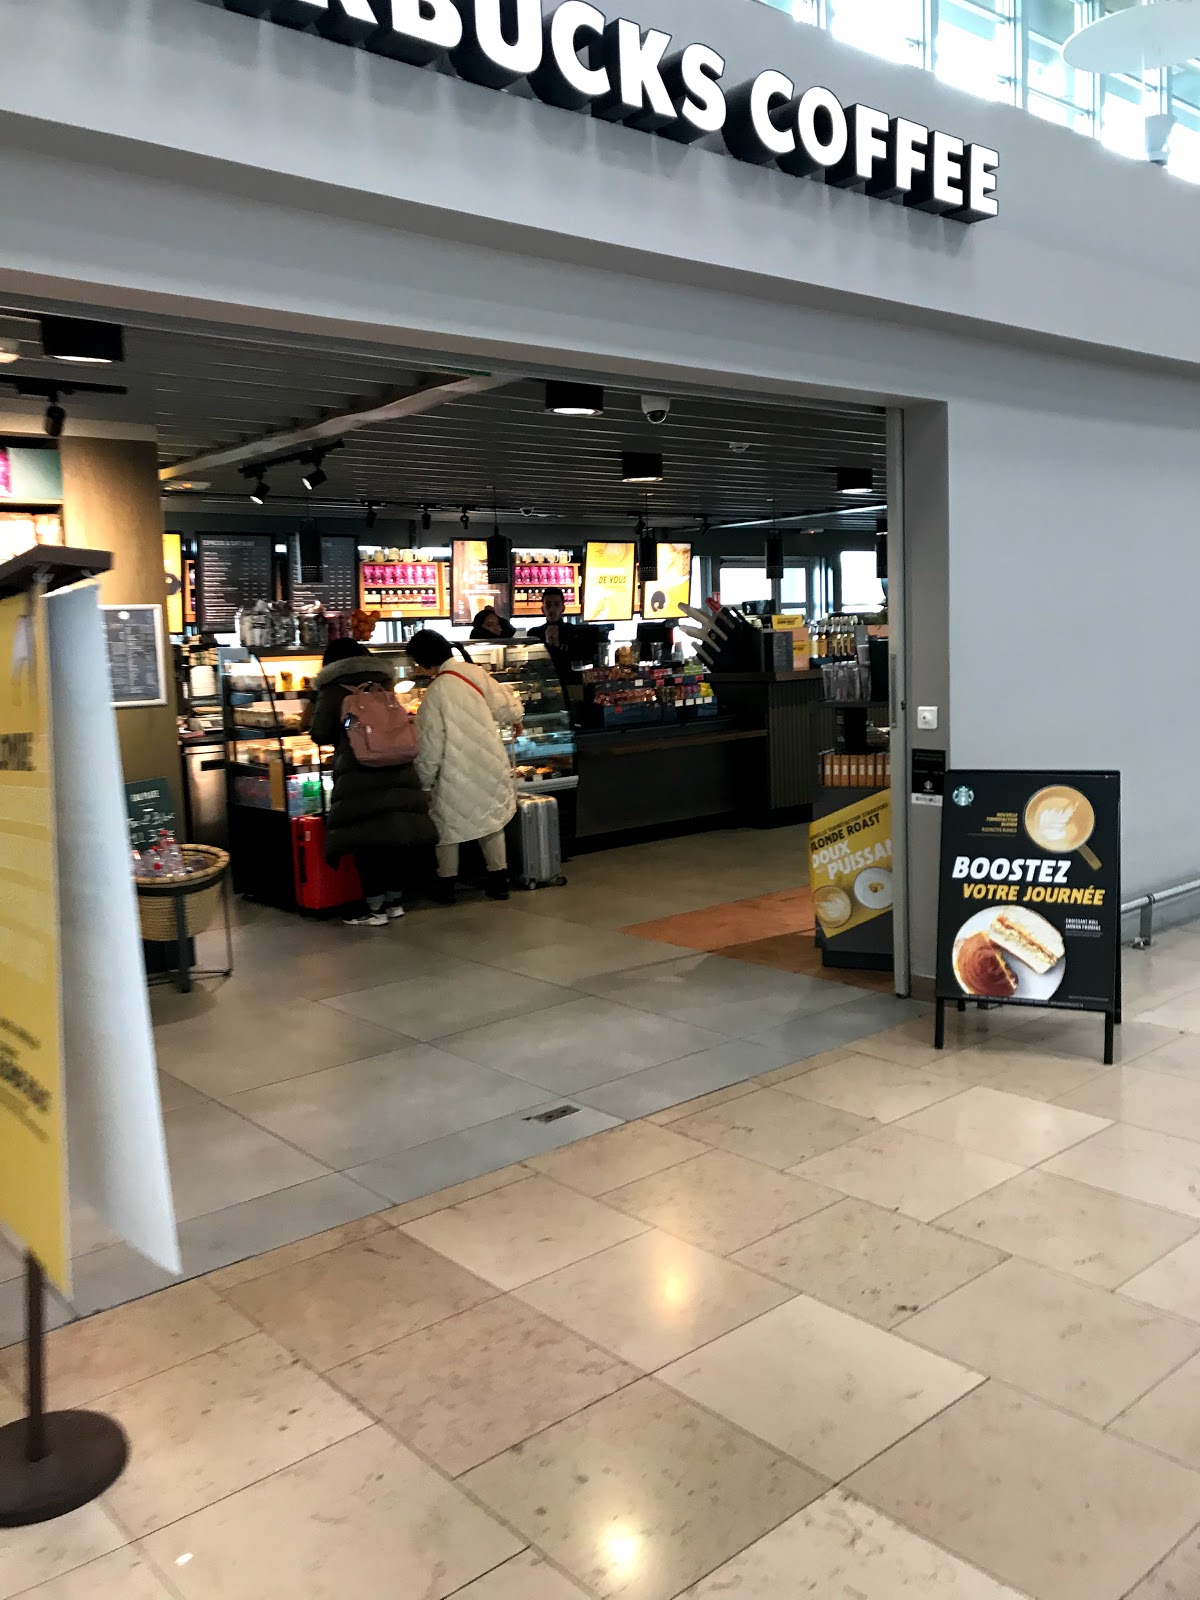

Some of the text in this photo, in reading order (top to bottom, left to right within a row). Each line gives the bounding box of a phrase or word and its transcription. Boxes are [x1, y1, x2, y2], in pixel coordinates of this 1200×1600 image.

[297, 0, 999, 218] UCKS COFFEE
[598, 576, 627, 584] DE VOUS
[846, 813, 881, 836] ROAST
[812, 840, 851, 869] DOUX
[952, 856, 1071, 883] BOOSTEZ
[962, 883, 1106, 906] VOTRE JOURNÉE
